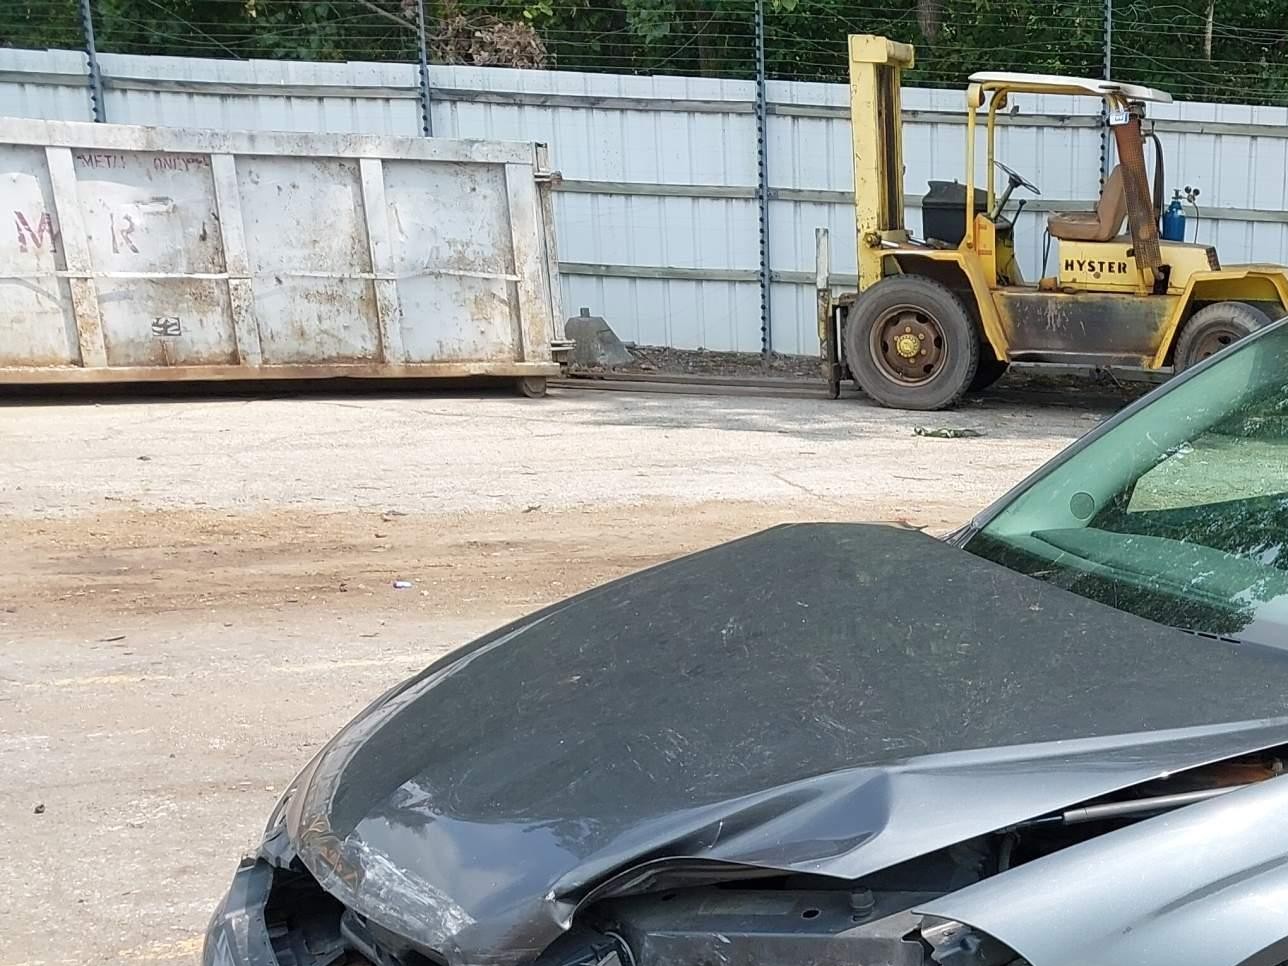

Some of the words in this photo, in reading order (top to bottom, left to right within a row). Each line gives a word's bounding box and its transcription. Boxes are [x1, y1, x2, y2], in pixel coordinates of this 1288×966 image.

[15, 211, 57, 253] M
[110, 213, 139, 254] R
[1064, 259, 1128, 274] HYSTER
